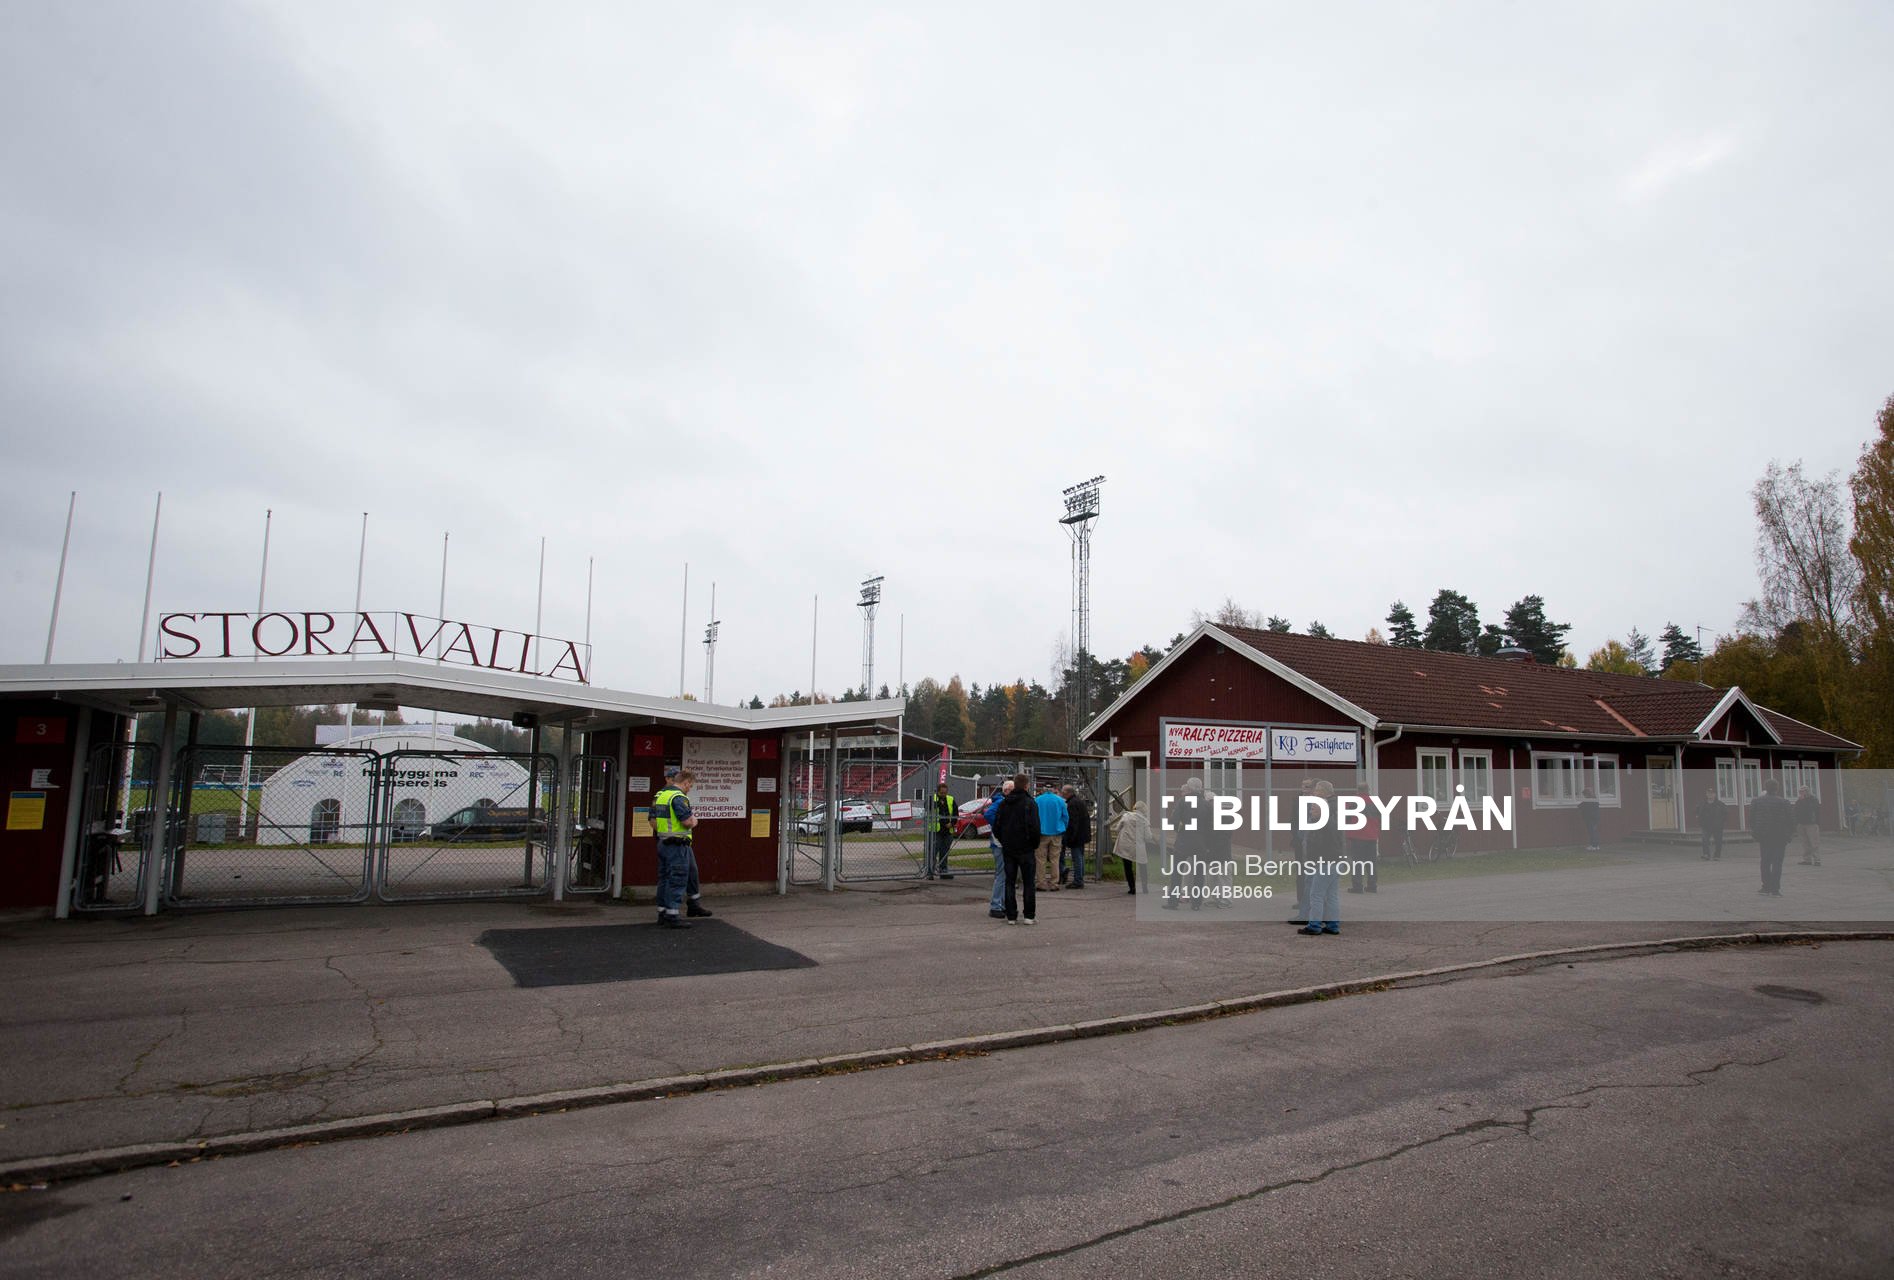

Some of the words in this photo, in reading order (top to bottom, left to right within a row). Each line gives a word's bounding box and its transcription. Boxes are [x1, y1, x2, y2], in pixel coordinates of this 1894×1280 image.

[160, 612, 393, 658] STORA
[401, 612, 588, 683] VALLA
[36, 723, 47, 735] 3
[1168, 727, 1184, 737] NYA
[1182, 727, 1216, 742] RALFS
[1217, 729, 1263, 744] PIZZERIA
[645, 740, 652, 750] 2
[761, 744, 766, 753] 1
[1168, 747, 1181, 756] 459
[1183, 748, 1193, 756] 99
[1195, 745, 1212, 754] PIZZA
[1304, 736, 1354, 755] Fastigheter
